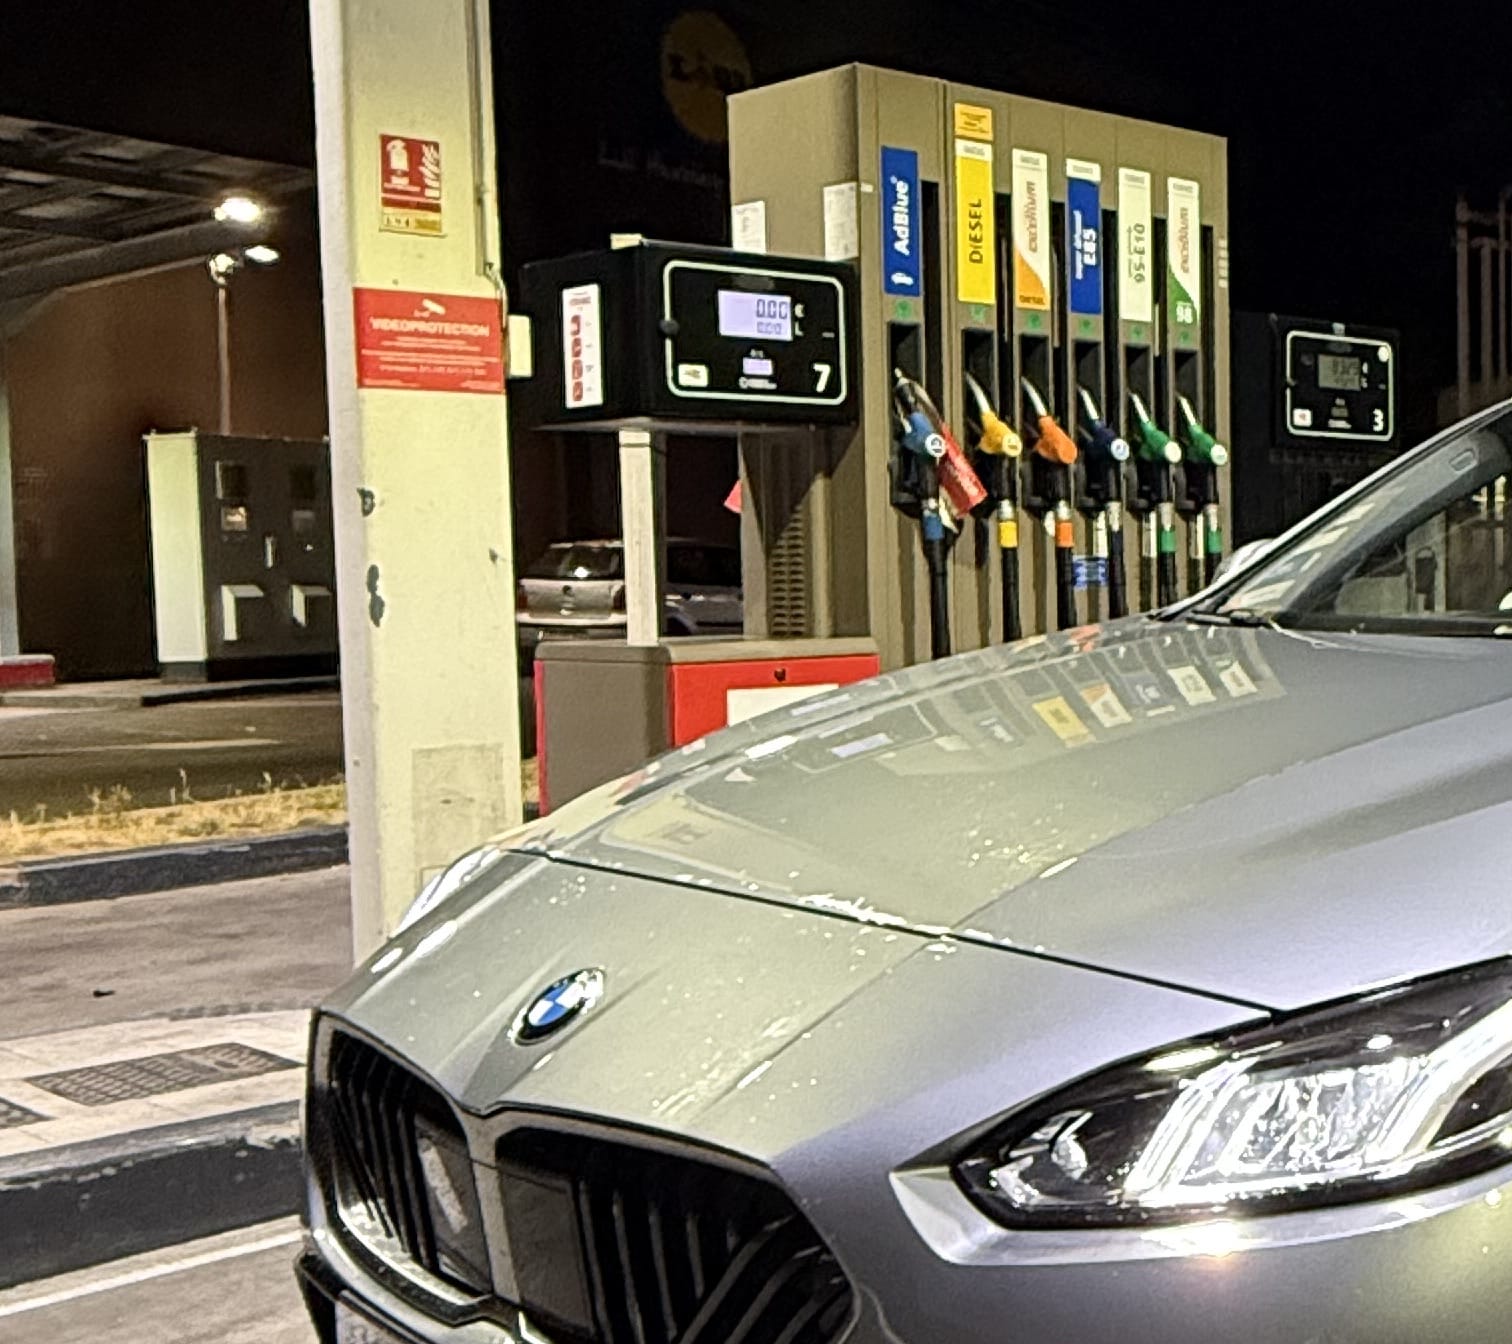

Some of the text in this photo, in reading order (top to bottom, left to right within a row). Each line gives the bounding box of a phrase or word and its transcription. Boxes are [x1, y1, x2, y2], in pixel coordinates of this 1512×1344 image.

[968, 198, 984, 265] DIESEL
[811, 362, 832, 393] 7
[1372, 407, 1385, 433] 3
